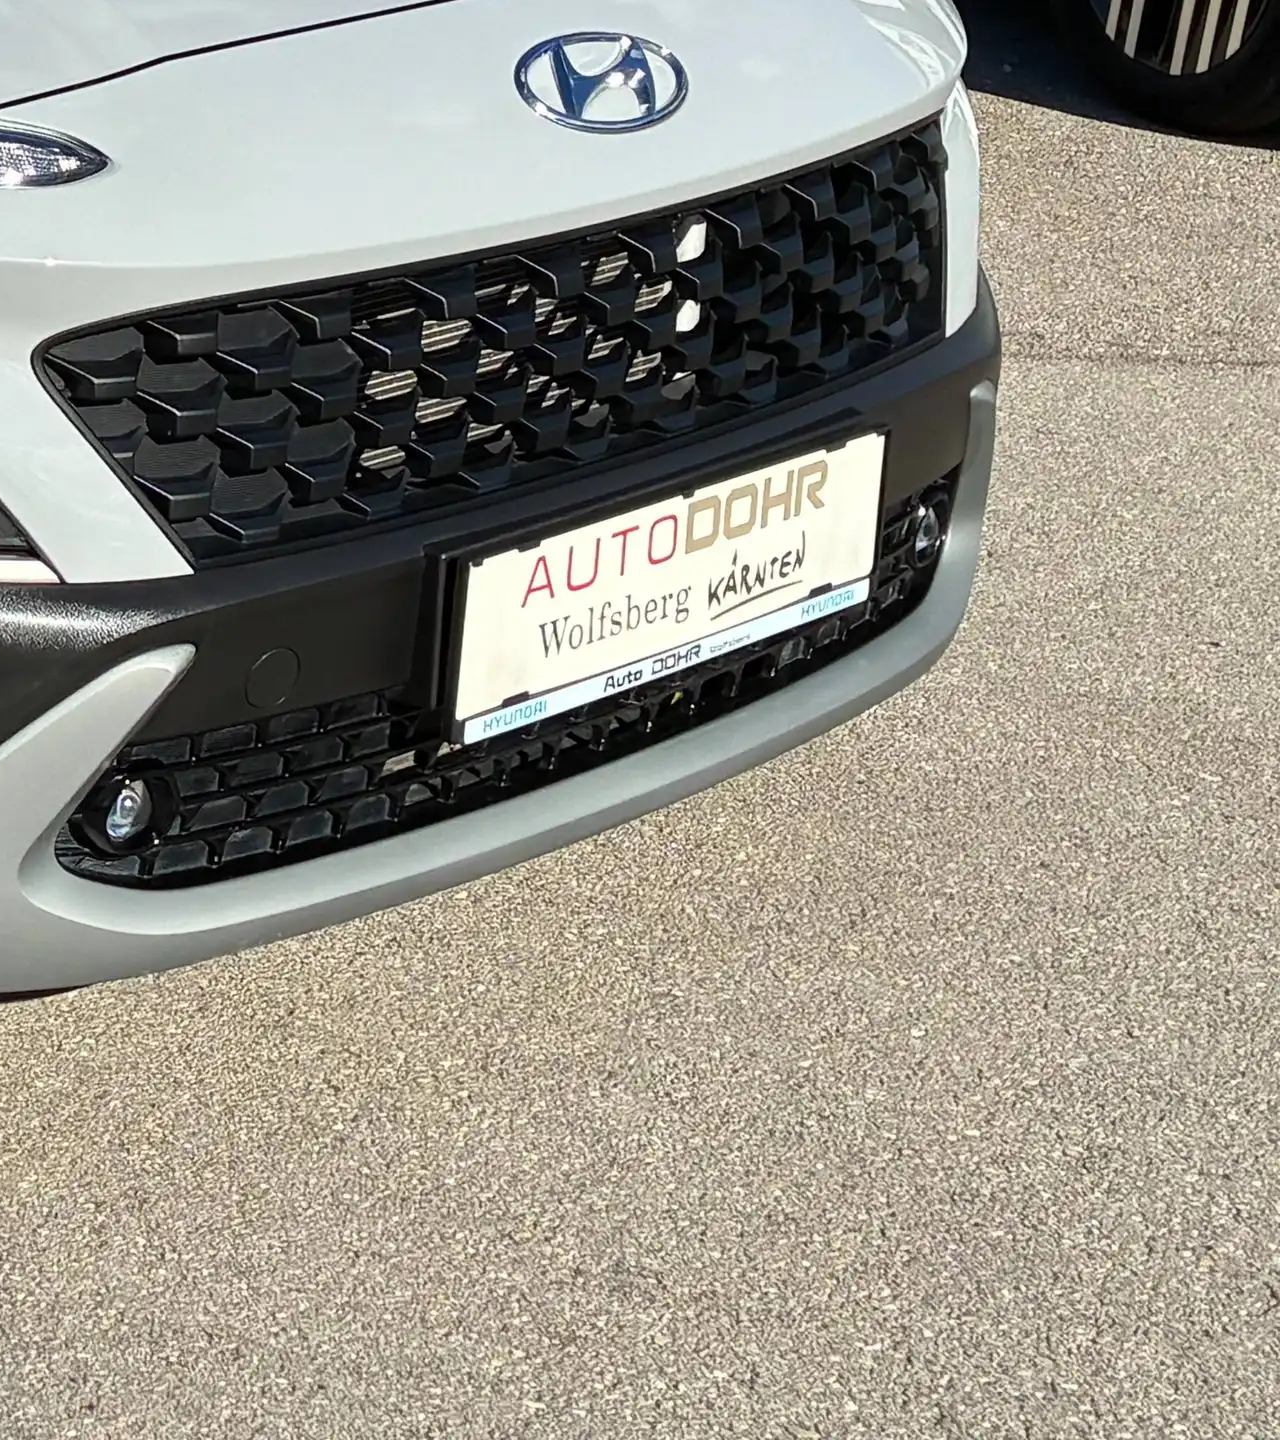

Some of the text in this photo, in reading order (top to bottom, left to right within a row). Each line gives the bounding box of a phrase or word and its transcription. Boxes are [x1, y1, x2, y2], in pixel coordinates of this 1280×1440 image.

[538, 585, 693, 659] Wolfsberg
[800, 589, 855, 620] HYUNDAI
[602, 669, 644, 693] Auto
[650, 643, 702, 675] DOHR
[482, 700, 548, 734] HYUNDAI
